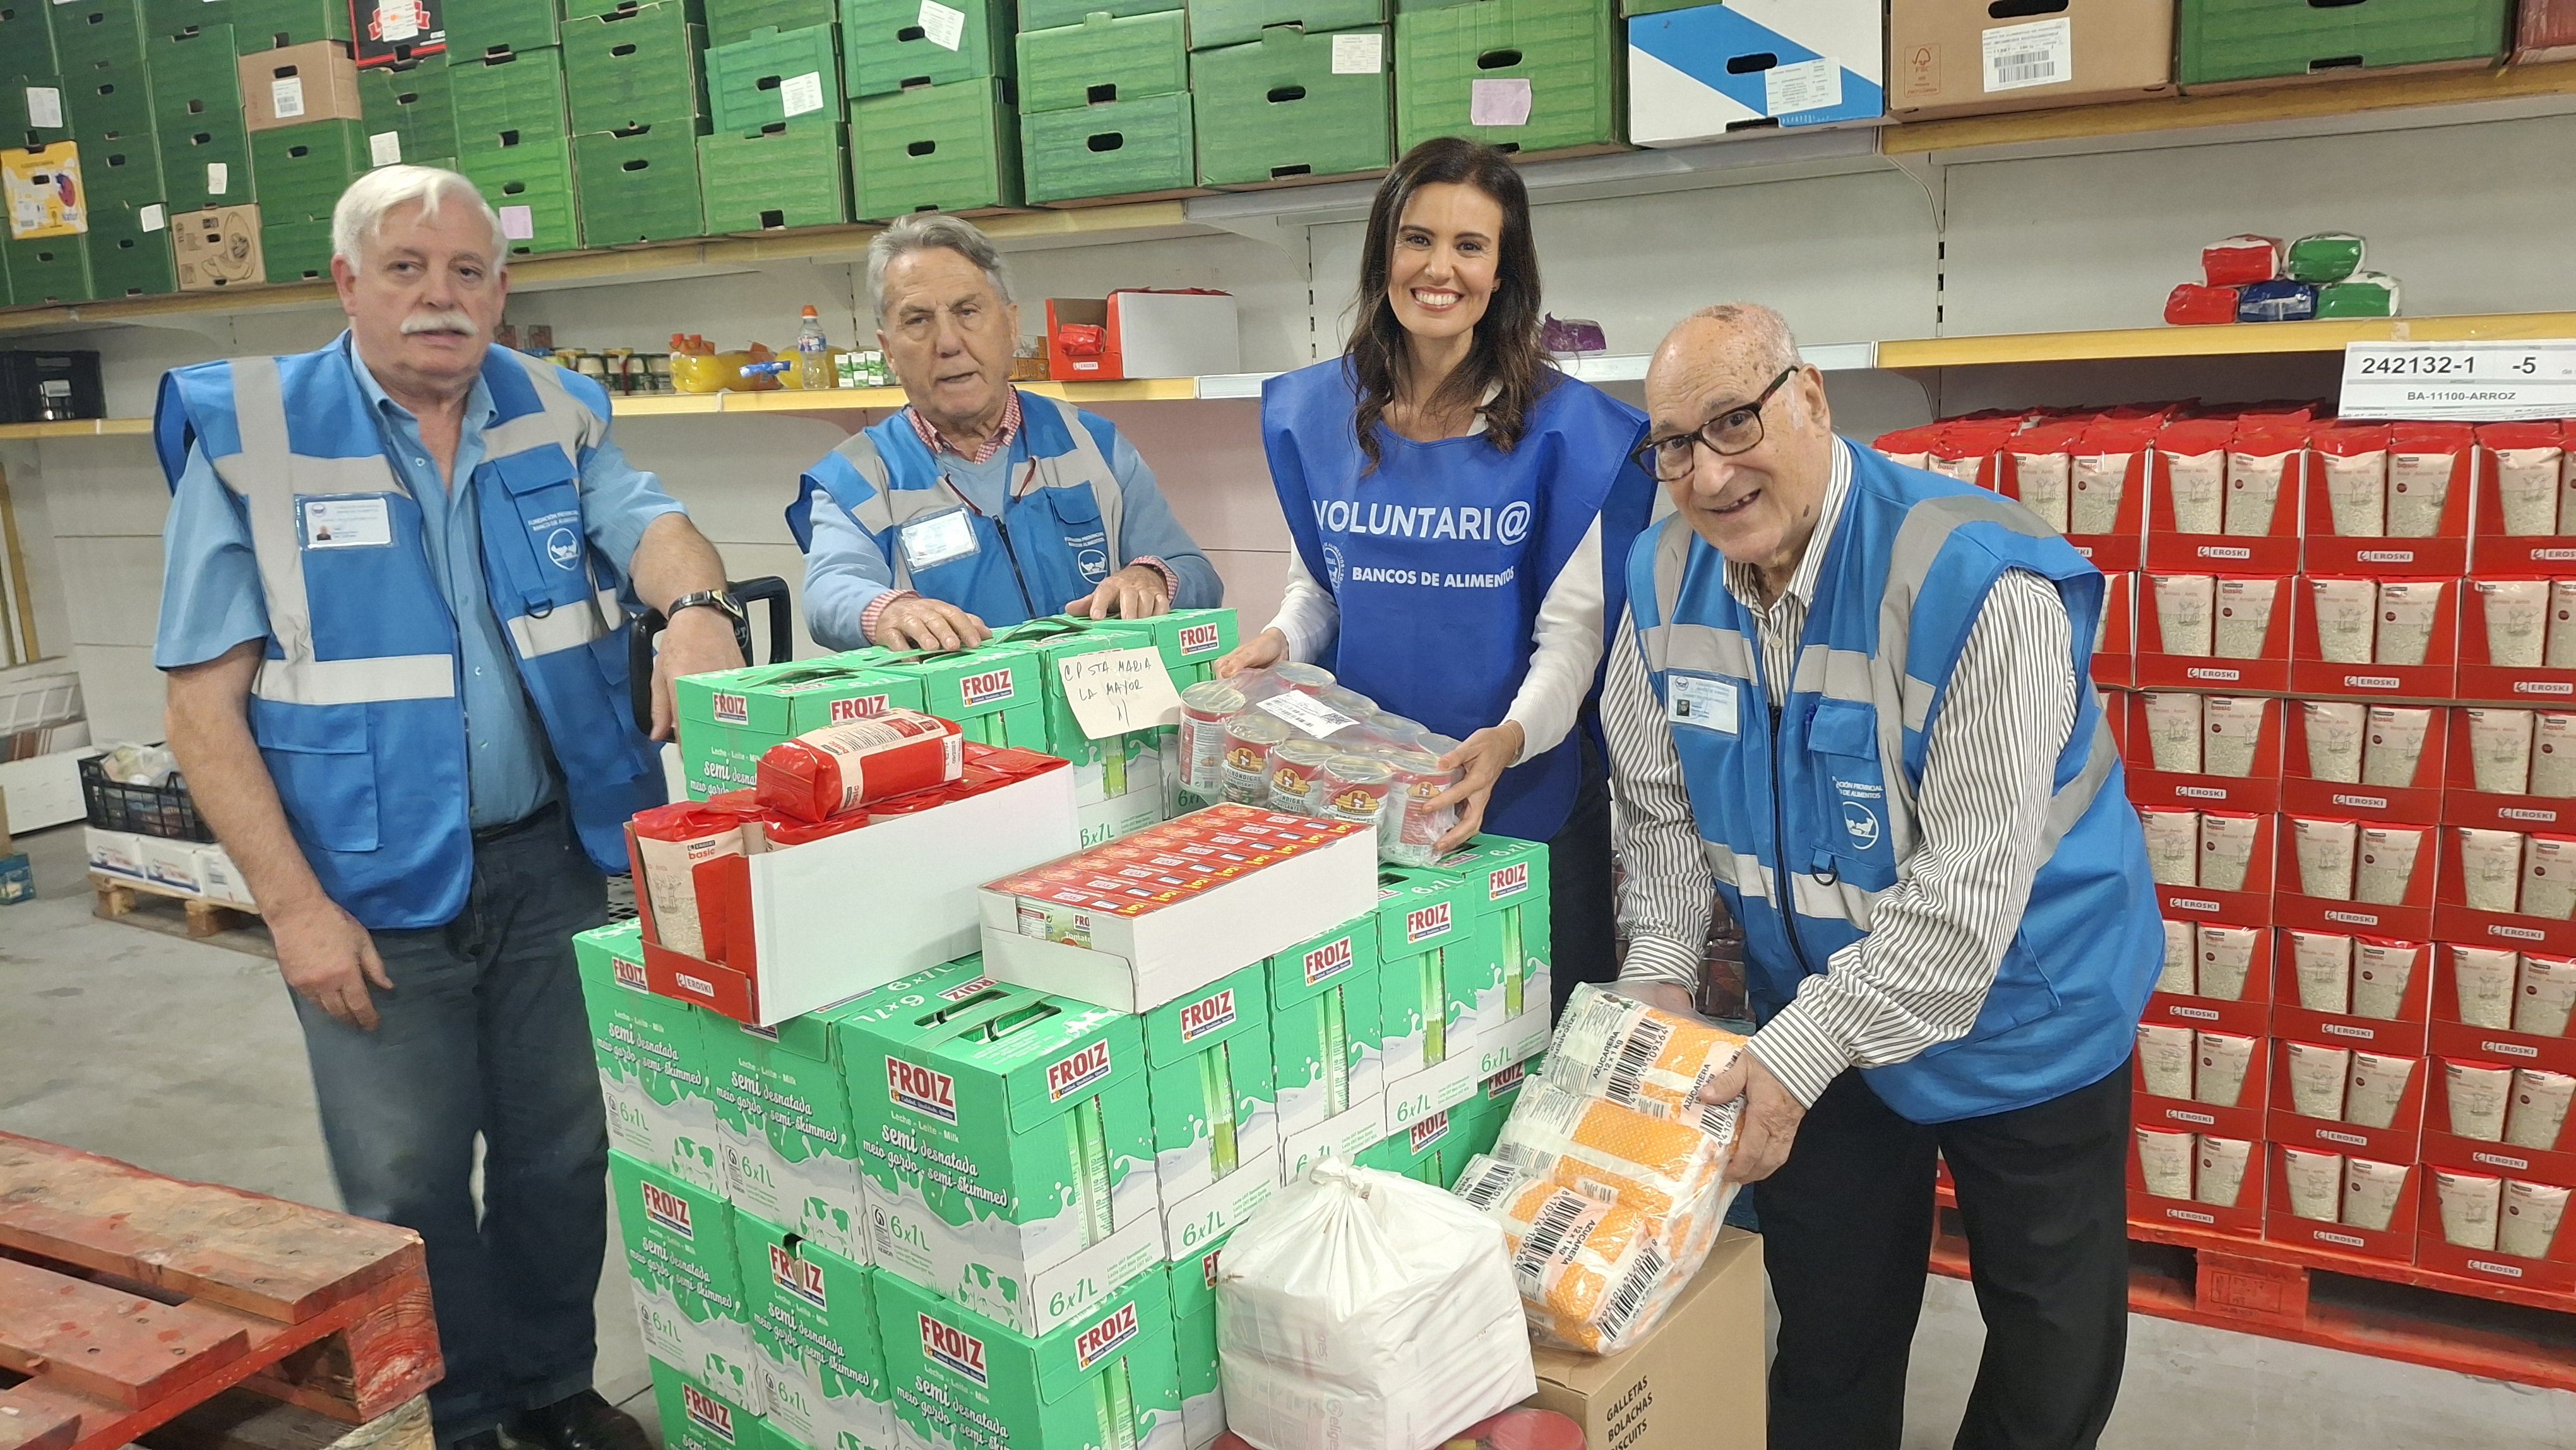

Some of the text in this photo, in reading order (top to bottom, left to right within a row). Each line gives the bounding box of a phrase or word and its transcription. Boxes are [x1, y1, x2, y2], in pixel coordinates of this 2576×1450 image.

[2361, 357, 2536, 374] 242132-1 -5
[2407, 392, 2516, 400] BA-11100-ARROZ
[1313, 500, 1530, 546] VOLUNTARI@
[2212, 549, 2247, 557] EROSKI
[1352, 566, 1514, 588] BANCOS DE ALIMENTOS
[1181, 624, 1217, 647] FROIZ
[963, 669, 1010, 698] FROIZ
[2360, 678, 2397, 686] EROSKI
[715, 695, 746, 715] FROIZ
[832, 695, 886, 721] FROIZ
[703, 758, 730, 781] semi
[2190, 789, 2223, 797] EROSKI
[2348, 798, 2383, 806] EROSKI
[2515, 812, 2553, 820] EROSKI
[688, 848, 716, 860] basic
[1410, 877, 1465, 894] 6x1L
[1490, 864, 1526, 890] FROIZ
[1408, 904, 1448, 932] FROIZ
[2184, 901, 2217, 909] EROSKI
[2339, 914, 2375, 923] EROSKI
[1075, 916, 1090, 927] FRO
[2504, 929, 2542, 938] EROSKI
[1306, 938, 1351, 975] FROIZ
[614, 960, 646, 985] FROIZ
[687, 978, 713, 994] EROSKI
[852, 994, 925, 1023] 6x1L
[1181, 990, 1232, 1031] FROIZ
[2184, 1009, 2216, 1019] EROSKI
[609, 1022, 680, 1062] semi desnatada
[1646, 1028, 1669, 1062] 109364
[2337, 1027, 2371, 1037] EROSKI
[596, 1038, 703, 1086] meio gordo semi-skimmed
[1481, 1047, 1512, 1072] 6x1L
[1592, 1031, 1621, 1080] AZUCARERA
[1603, 1064, 1611, 1072] 12
[1613, 1040, 1624, 1051] kg
[2498, 1045, 2535, 1055] EROSKI
[1050, 1041, 1108, 1090] FROIZ
[1489, 1060, 1523, 1088] FROIZ
[732, 1070, 813, 1117] semi desnatada
[888, 1057, 953, 1108] FROIZ
[1629, 1067, 1649, 1103] 410714
[1683, 1064, 1711, 1111] AZUCARERA
[620, 1102, 649, 1131] 6x1L
[717, 1086, 838, 1144] meio gordo semi-skimmed
[1397, 1094, 1431, 1122] 6x1L
[2179, 1113, 2212, 1123] EROSKI
[891, 1110, 960, 1143] Leche Leite Milk
[1411, 1110, 1448, 1145] FROIZ
[2330, 1133, 2364, 1144] EROSKI
[881, 1123, 979, 1178] semi desnatada
[2489, 1156, 2525, 1168] EROSKI
[742, 1156, 776, 1189] 6x1L
[863, 1139, 1009, 1209] meio gordo semi-skimmed
[643, 1182, 690, 1226] FROIZ
[2179, 1212, 2212, 1223] EROSKI
[891, 1215, 930, 1252] 6x1L
[1183, 1211, 1225, 1247] 6x1L
[1561, 1219, 1596, 1265] AZUCARERA
[1573, 1225, 1583, 1235] 12
[2328, 1234, 2362, 1245] EROSKI
[642, 1236, 669, 1262] semi
[1558, 1245, 1568, 1255] kg
[770, 1244, 823, 1295] FRIZ
[2483, 1263, 2519, 1276] EROSKI
[1049, 1277, 1099, 1317] 6x1L
[653, 1312, 682, 1343] 6x1L
[768, 1301, 845, 1358] semi desnatada
[774, 1326, 799, 1348] gordo
[1077, 1303, 1135, 1358] FROIZ
[920, 1314, 984, 1371] FROIZ
[683, 1383, 732, 1430] FROIZ
[778, 1381, 811, 1417] 6x1L
[897, 1385, 952, 1427] meio gordo
[915, 1375, 1010, 1441] semi desnatada
[1607, 1375, 1648, 1422] GALLETAS
[1608, 1391, 1653, 1443] BOLACHAS
[1611, 1418, 1647, 1450] ISCUITS
